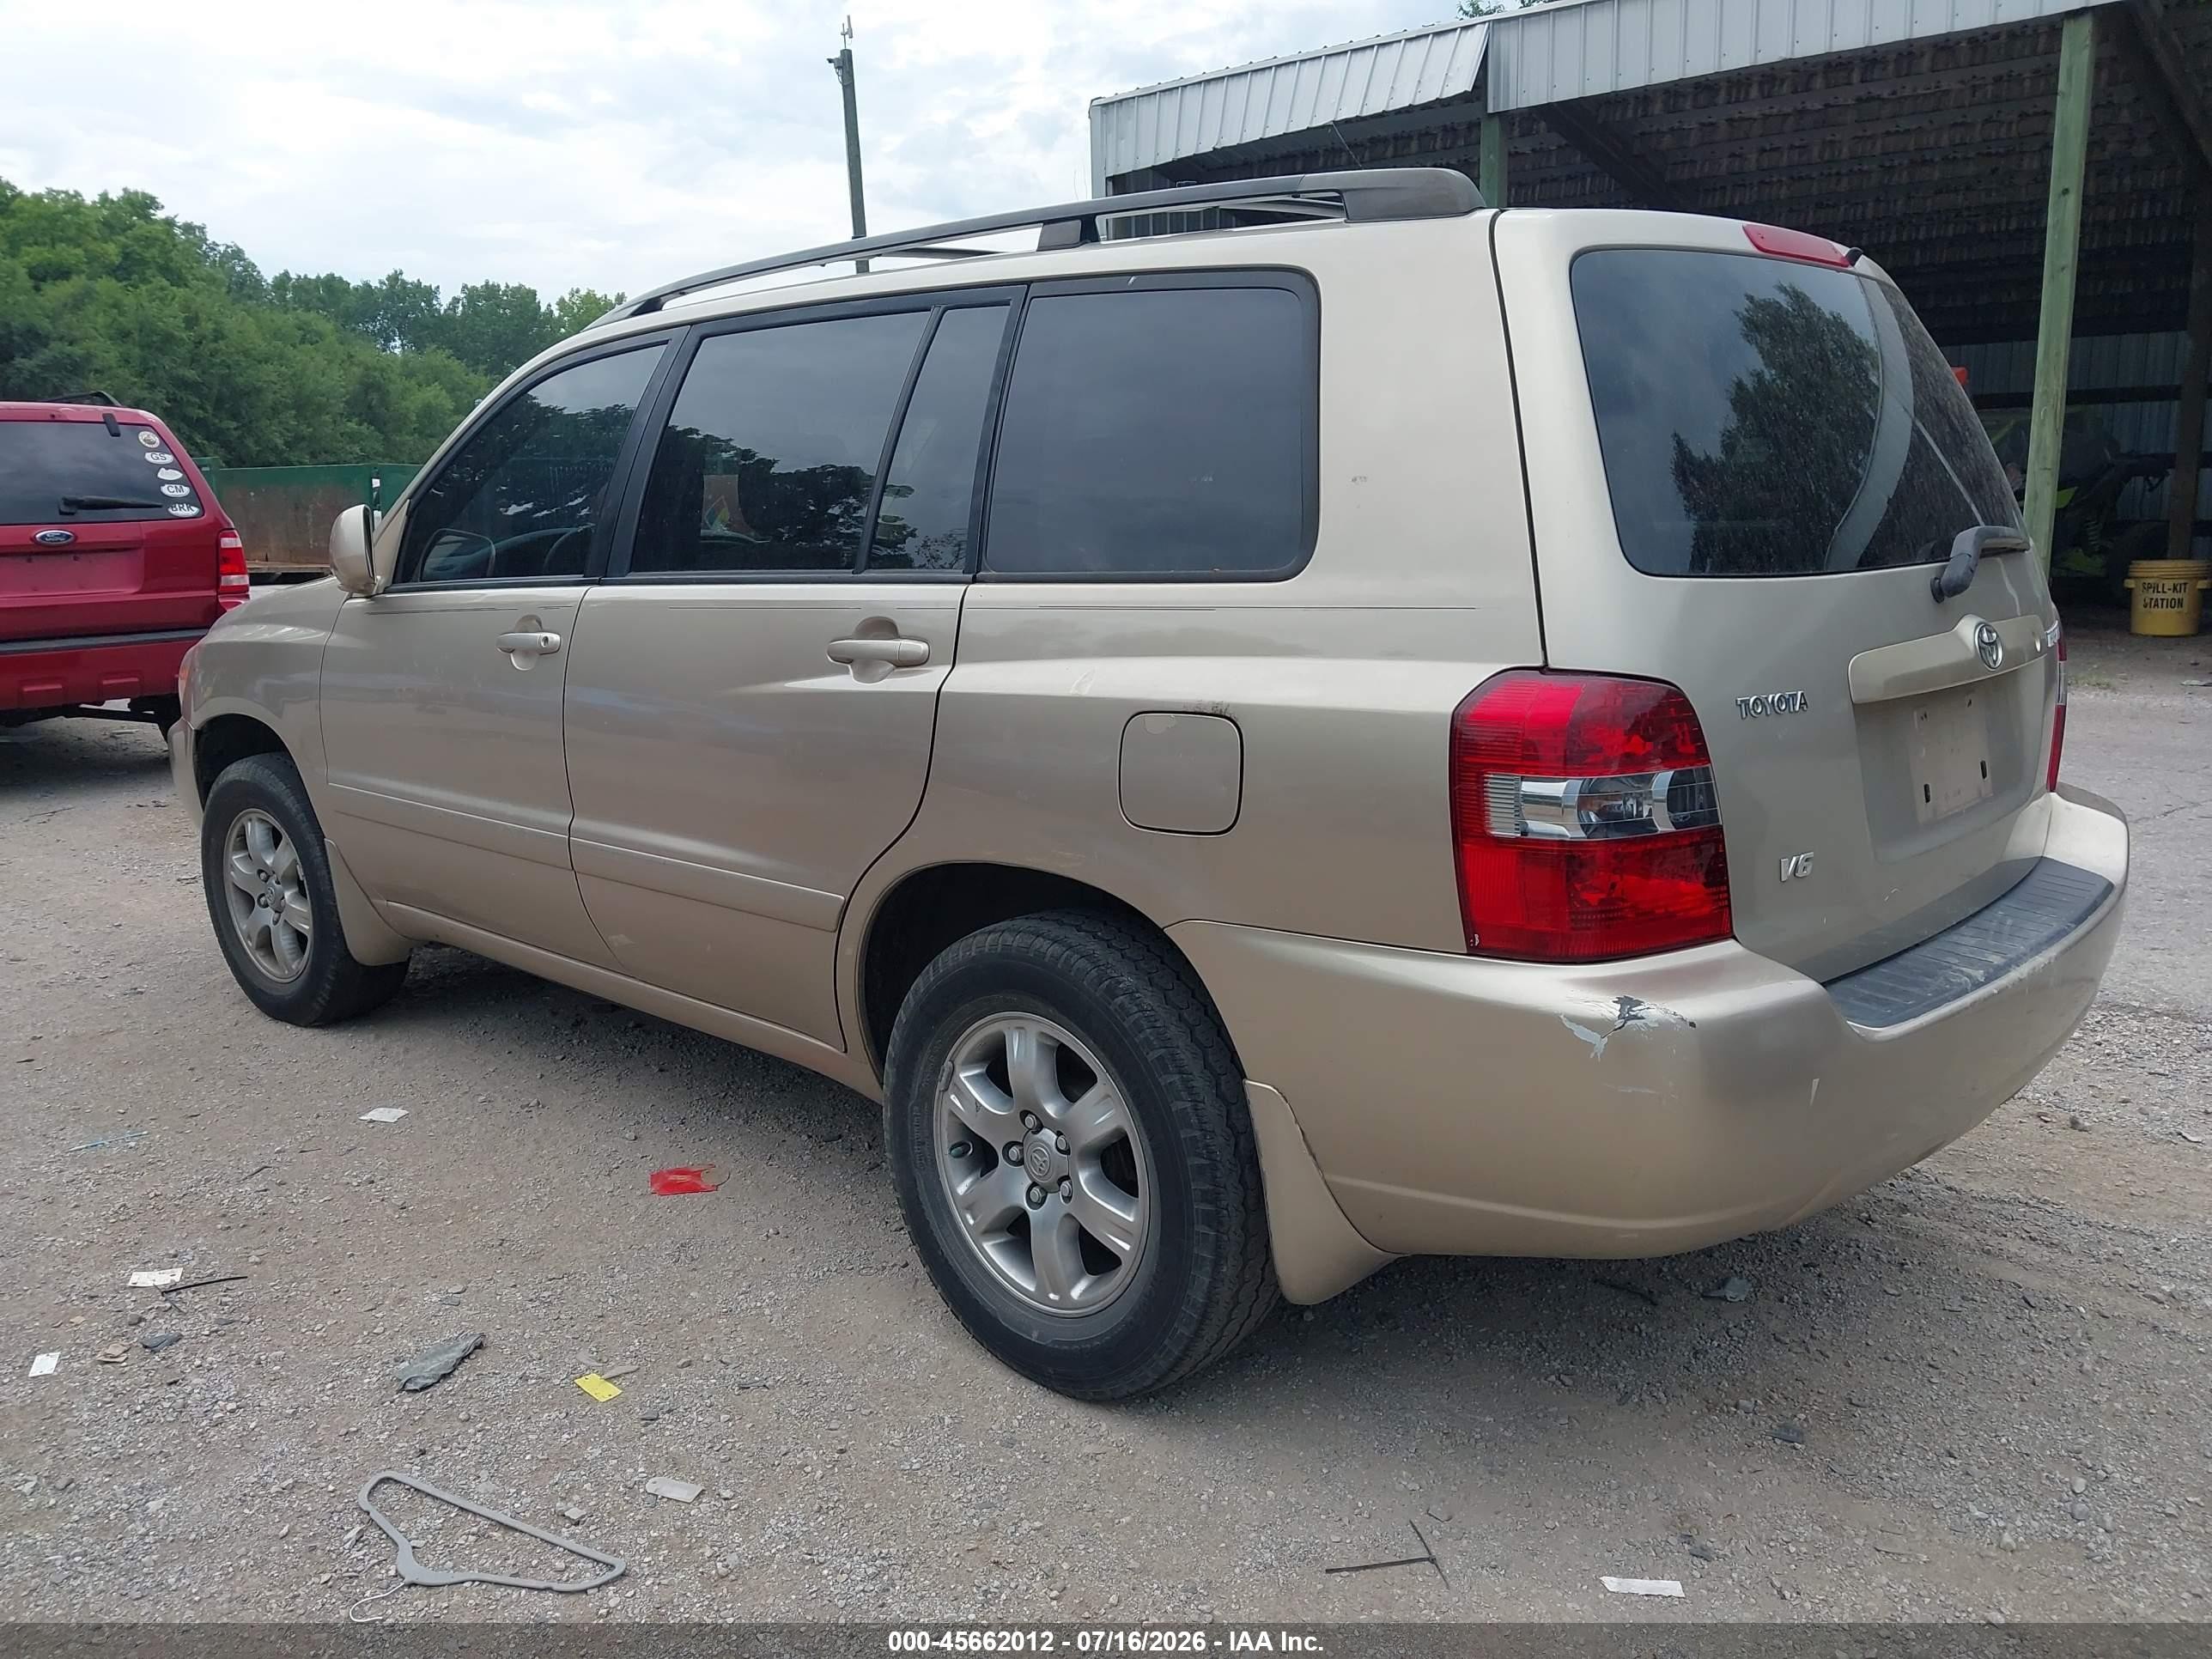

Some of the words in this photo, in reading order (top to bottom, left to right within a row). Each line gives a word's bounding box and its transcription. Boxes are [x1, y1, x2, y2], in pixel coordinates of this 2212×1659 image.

[150, 453, 167, 461] GS
[167, 485, 184, 494] CM
[2142, 582, 2189, 593] SPILL-KIT
[2143, 598, 2184, 609] STATION
[1735, 690, 1808, 720] TOYOTA
[1779, 852, 1814, 882] V6
